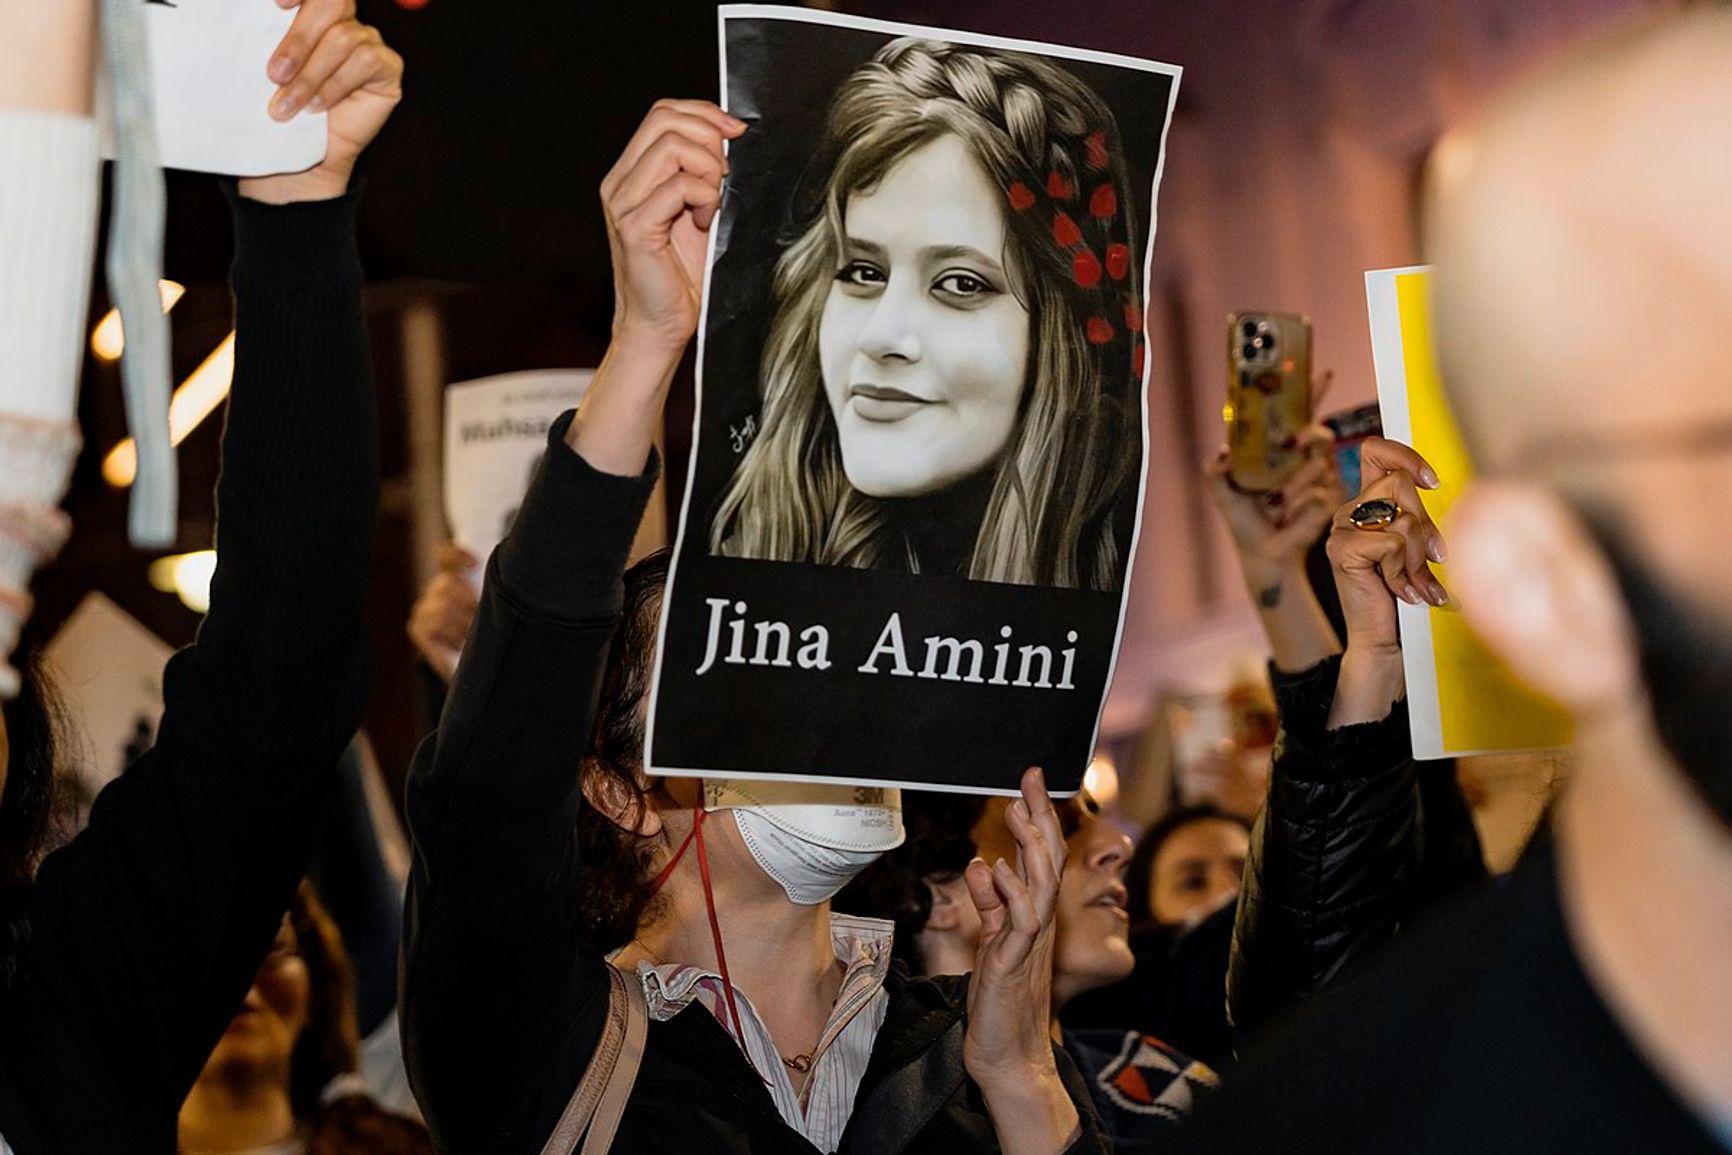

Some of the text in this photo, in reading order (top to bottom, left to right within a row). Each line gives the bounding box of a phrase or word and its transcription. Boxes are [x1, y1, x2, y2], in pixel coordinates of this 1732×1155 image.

[695, 597, 1079, 690] Jina Amini
[854, 786, 884, 804] 3M
